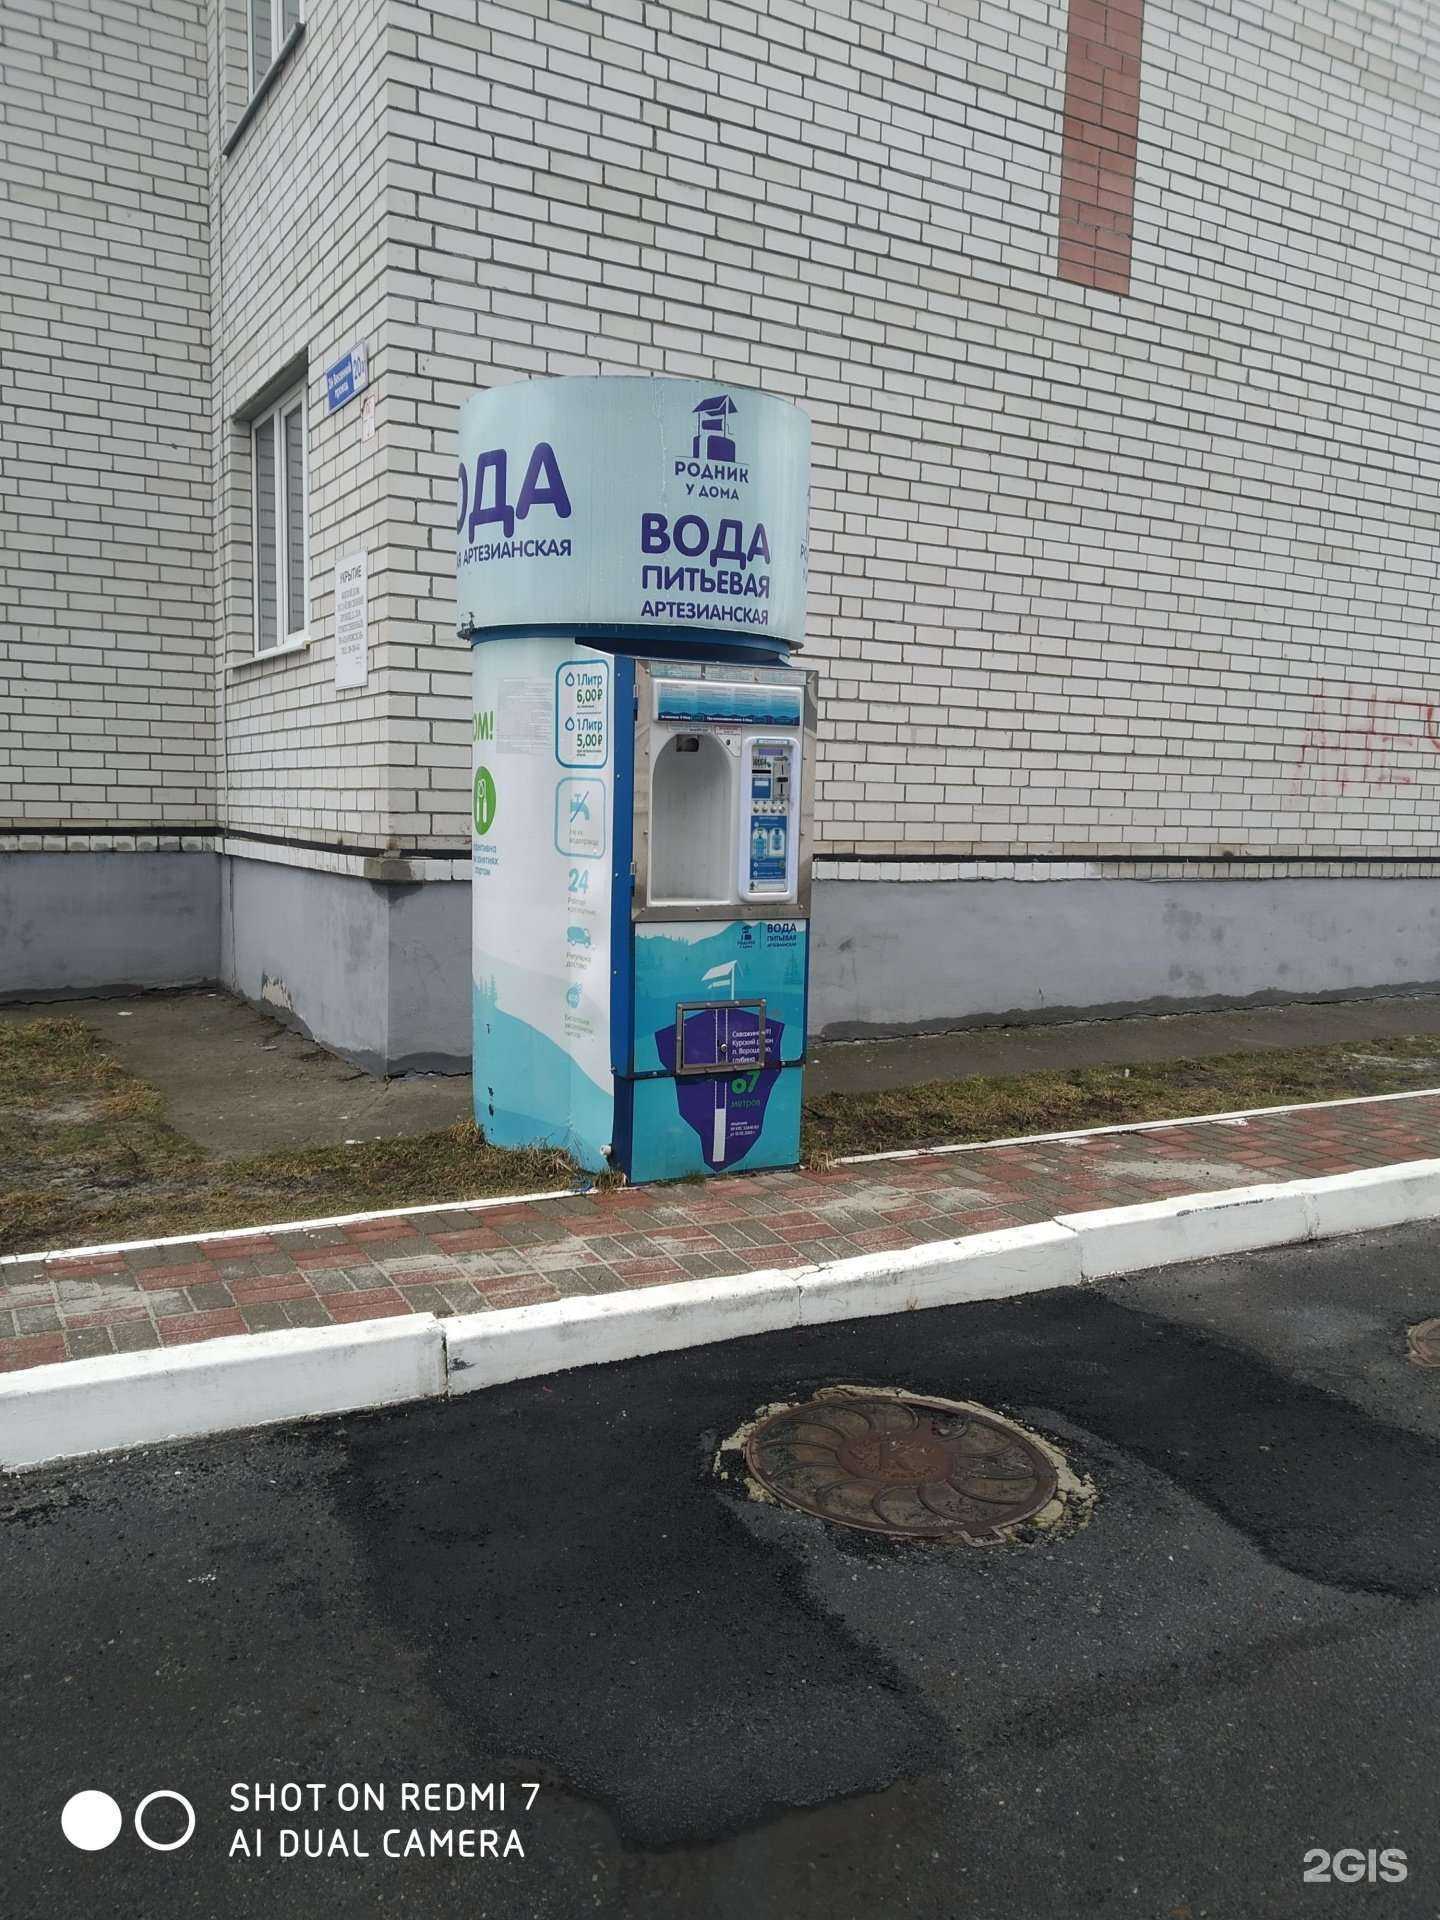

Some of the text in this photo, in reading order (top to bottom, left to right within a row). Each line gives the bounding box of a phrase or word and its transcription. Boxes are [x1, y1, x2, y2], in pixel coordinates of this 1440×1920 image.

[674, 461, 749, 483] РОДНИК
[686, 484, 739, 501] У ДОМА
[463, 539, 572, 565] АРТЕЗИАНСКАЯ
[641, 513, 771, 570] ВОДА
[642, 565, 770, 599] ПИТЬЕВАЯ
[641, 600, 769, 625] АРТЕЗИАНСКАЯ
[568, 868, 589, 894] 24
[767, 922, 797, 934] ВОДА
